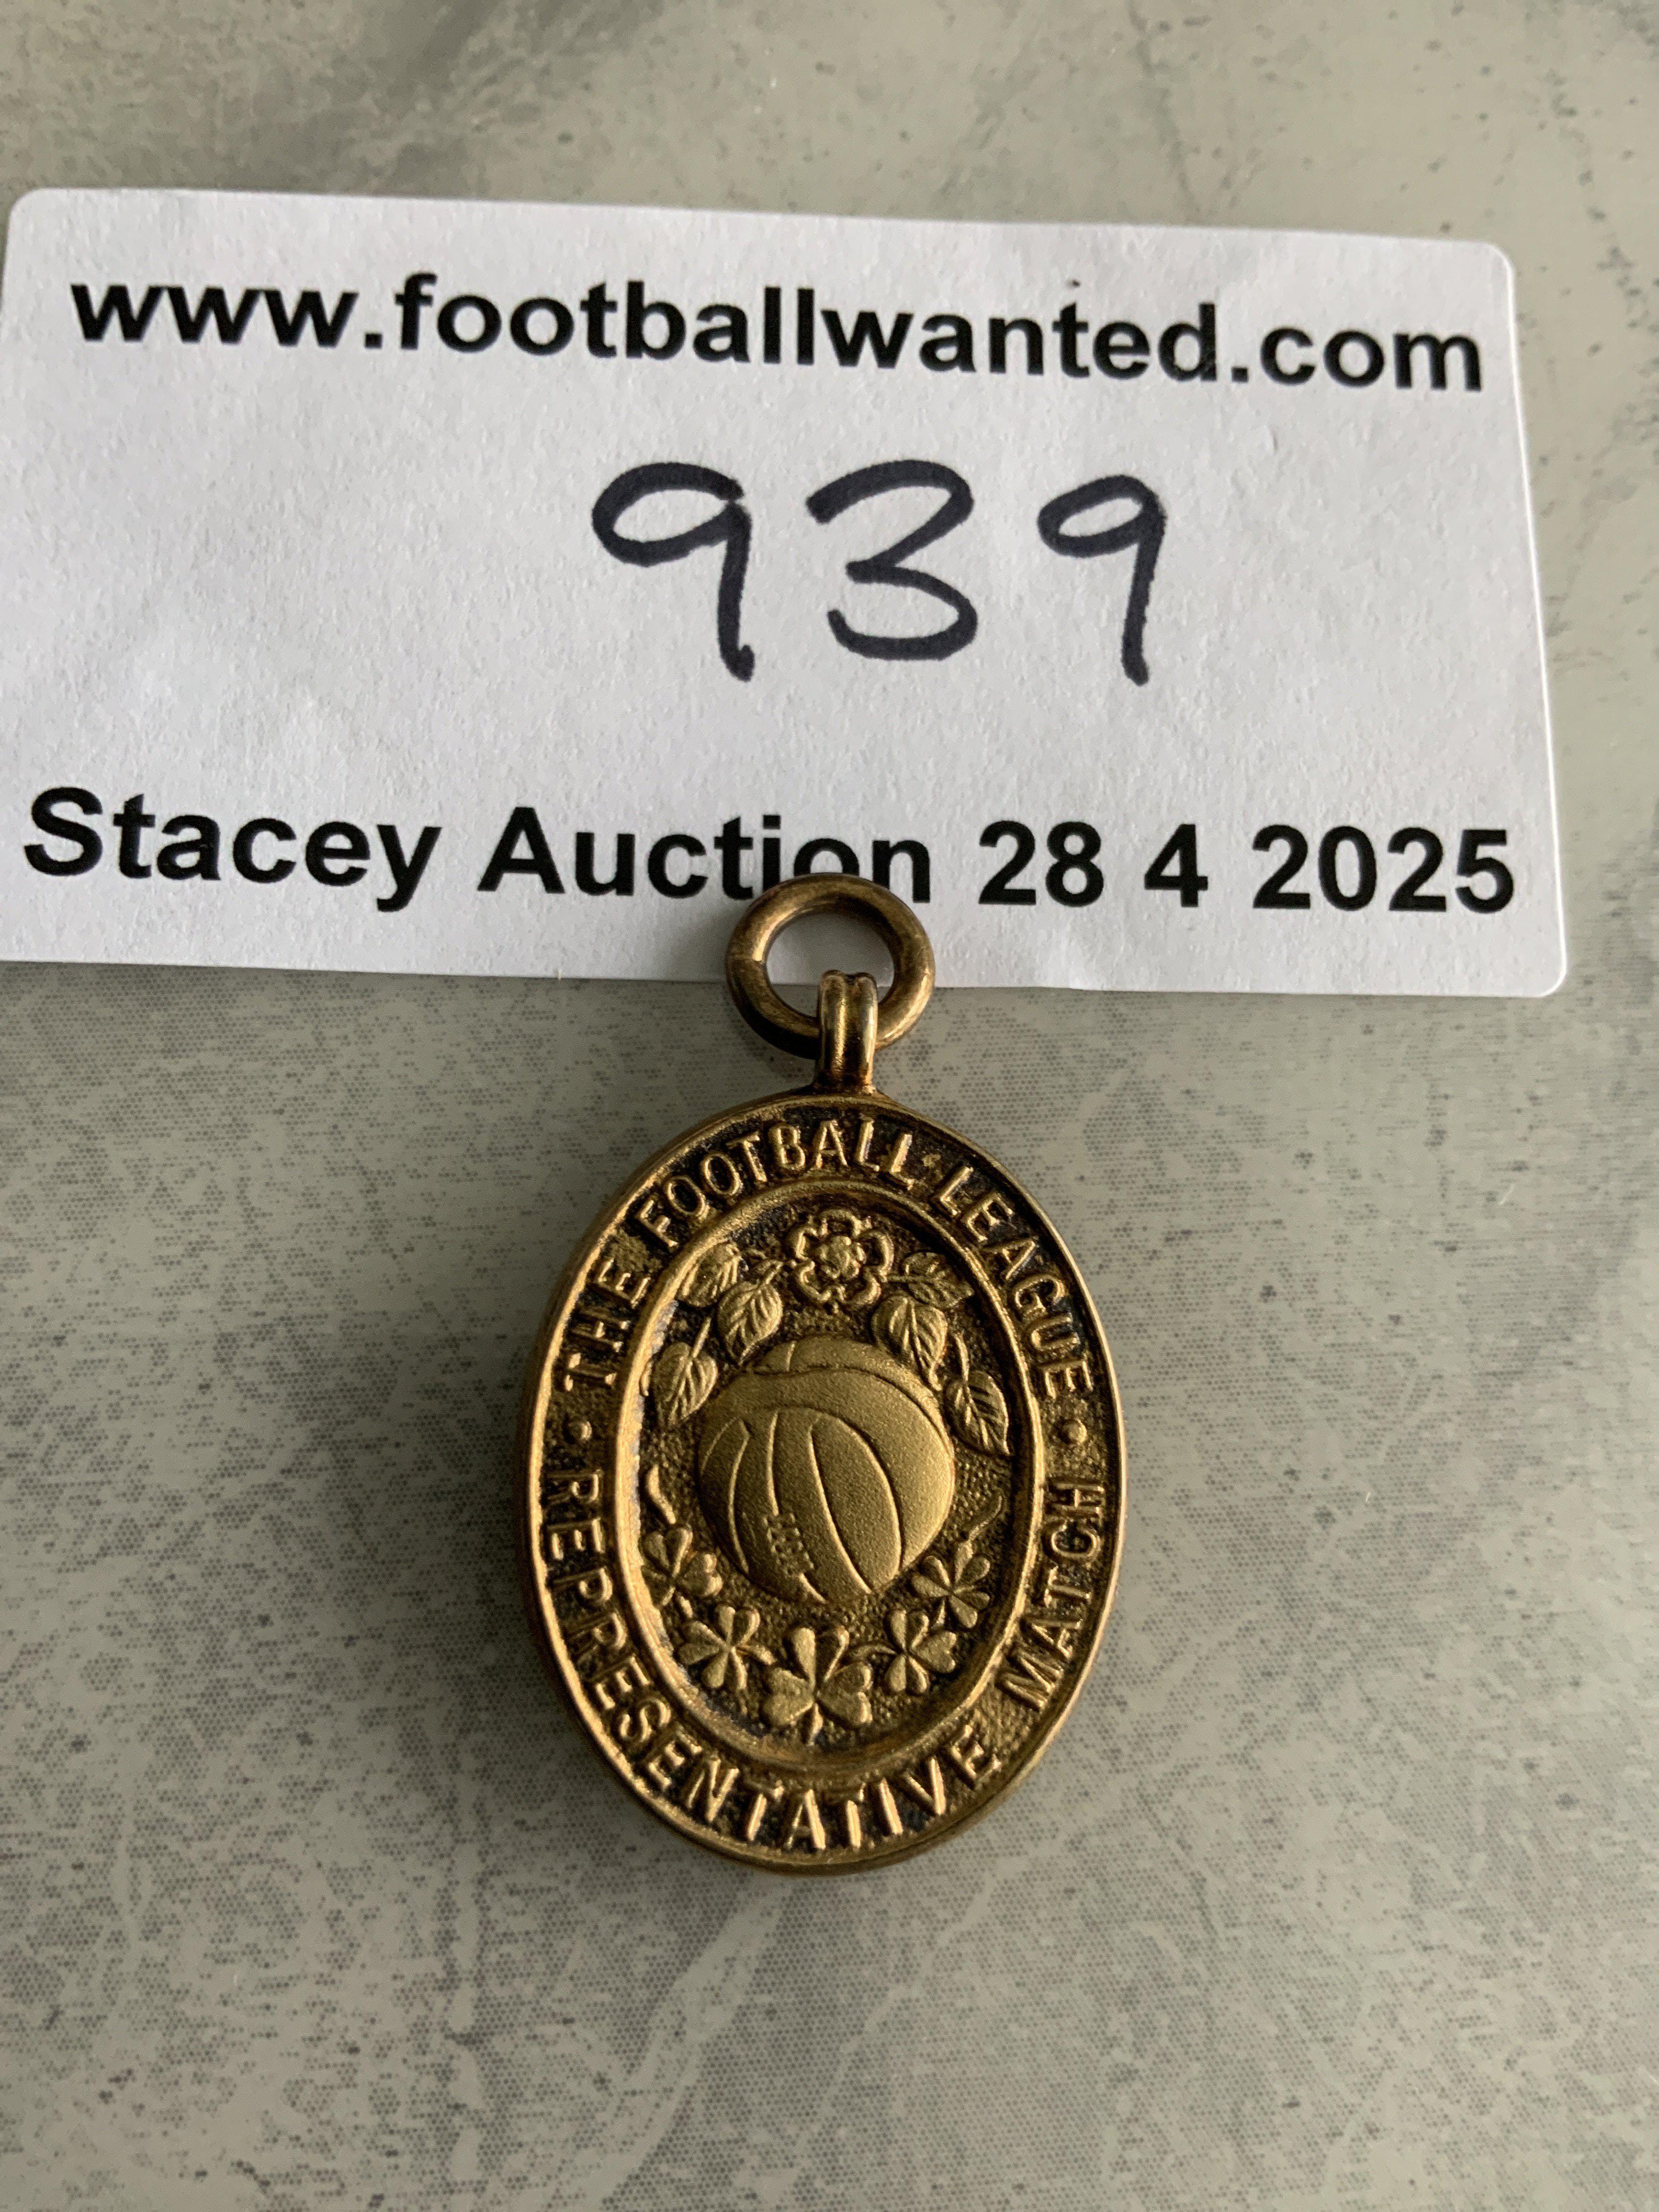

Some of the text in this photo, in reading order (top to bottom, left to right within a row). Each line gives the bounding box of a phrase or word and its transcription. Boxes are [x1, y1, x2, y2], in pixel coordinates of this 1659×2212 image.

[71, 272, 1481, 392] www.footballwanted.com
[591, 459, 1167, 687] 939
[24, 786, 441, 912] Stacey
[979, 820, 1104, 907] 28
[1144, 823, 1209, 908] 4
[1252, 824, 1514, 913] 2025
[562, 1117, 1095, 1400] THE FOOTBALL LEAGUE
[549, 1468, 1106, 1851] REPRESENTATIVE MATCH
